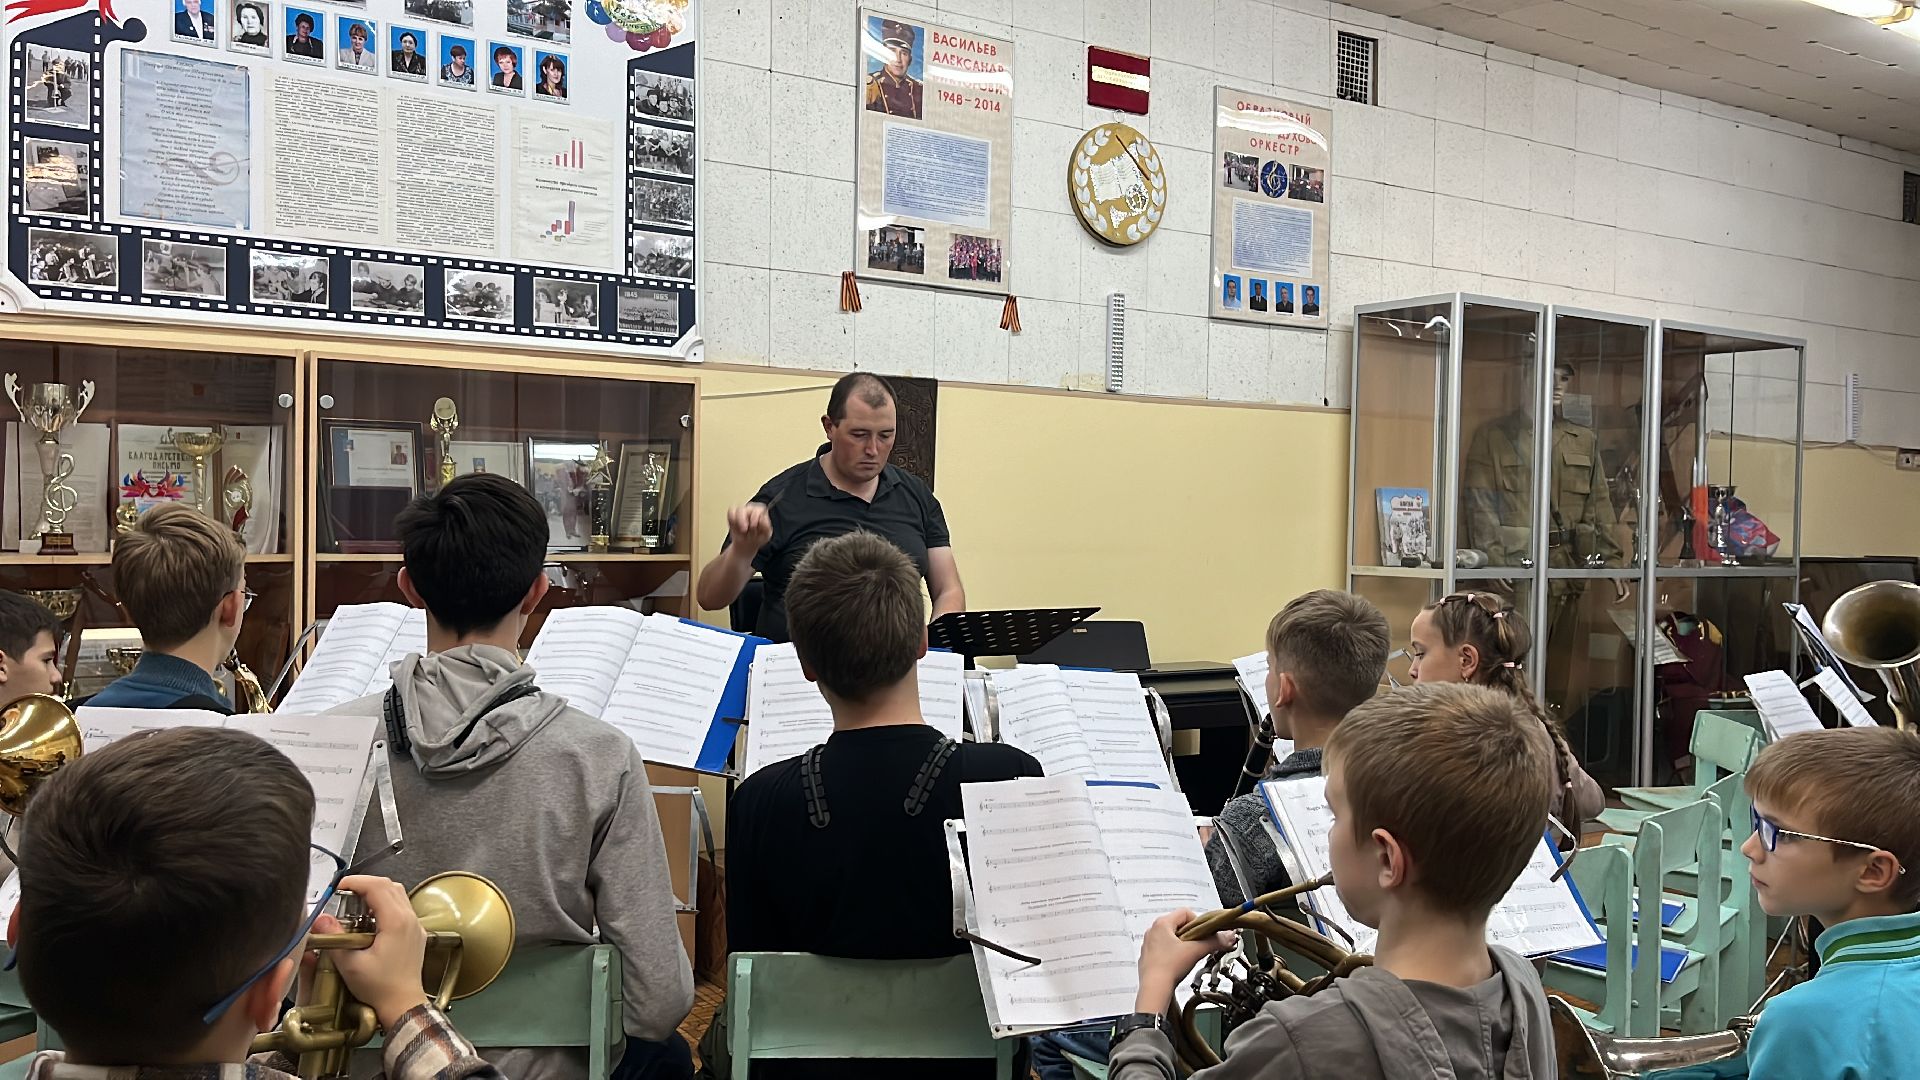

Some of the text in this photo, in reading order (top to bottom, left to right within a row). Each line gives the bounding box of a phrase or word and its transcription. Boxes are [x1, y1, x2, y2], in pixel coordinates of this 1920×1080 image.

[933, 32, 997, 56] ВАСИЛЬЕВ
[932, 51, 1004, 73] АЛЕКСАНДР
[1250, 137, 1300, 155] ОРКЕСТР
[1277, 132, 1318, 145] ДУХОВ
